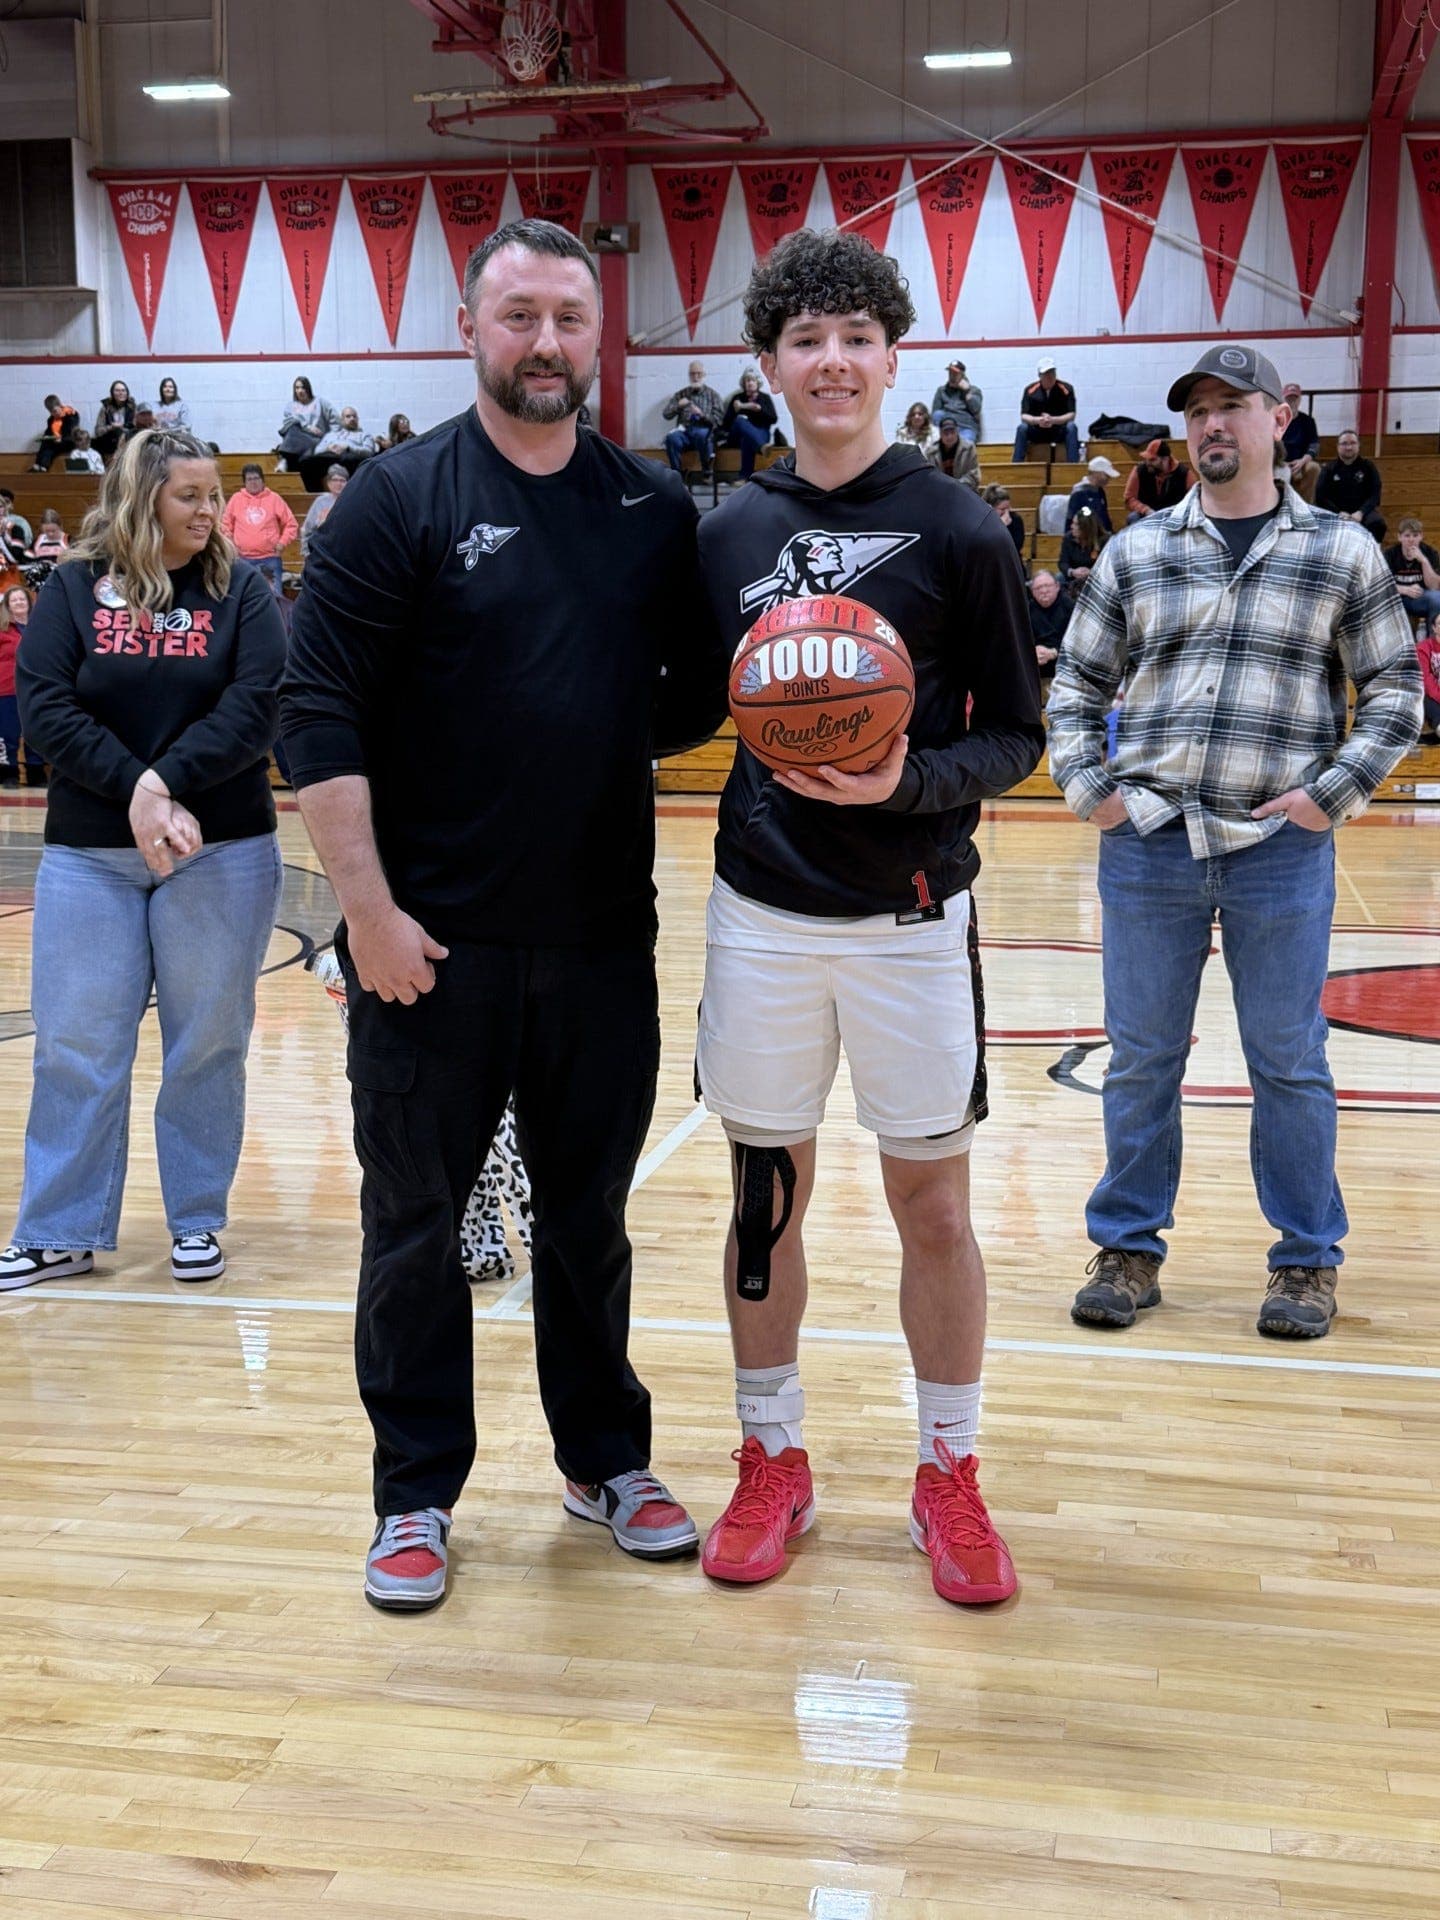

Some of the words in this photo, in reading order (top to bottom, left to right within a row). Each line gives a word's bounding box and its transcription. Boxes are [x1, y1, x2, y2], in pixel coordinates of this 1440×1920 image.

[1051, 160, 1070, 175] AA
[1103, 156, 1138, 175] OVAC
[1142, 156, 1160, 172] AA
[1195, 151, 1230, 171] OVAC
[1235, 153, 1253, 169] AA
[1280, 149, 1316, 170] OVAC
[750, 167, 784, 186] OVAC
[837, 165, 870, 184] OVAC
[874, 167, 891, 181] AA
[961, 163, 979, 179] AA
[279, 184, 309, 201] OVAC
[313, 185, 329, 201] AA
[358, 184, 387, 202] OVAC
[392, 184, 417, 200] AAA
[444, 179, 474, 196] OVAC
[478, 180, 494, 195] AA
[1200, 187, 1248, 204] CHAMPS
[1291, 184, 1339, 200] CHAMPS
[118, 188, 145, 206] OVAC
[929, 198, 974, 213] CHAMPS
[1018, 193, 1065, 210] CHAMPS
[1109, 190, 1154, 206] CHAMPS
[671, 206, 715, 221] CHAMPS
[756, 201, 800, 217] CHAMPS
[206, 219, 245, 232] CHAMPS
[285, 216, 327, 230] CHAMPS
[367, 215, 409, 230] CHAMPS
[447, 210, 493, 226] CHAMPS
[127, 220, 168, 236] CHAMPS
[874, 617, 897, 646] 26
[93, 629, 208, 658] SISTER
[754, 635, 859, 686] 1000
[783, 679, 830, 699] POINTS
[761, 705, 874, 748] Rawlings
[911, 870, 932, 910] 1
